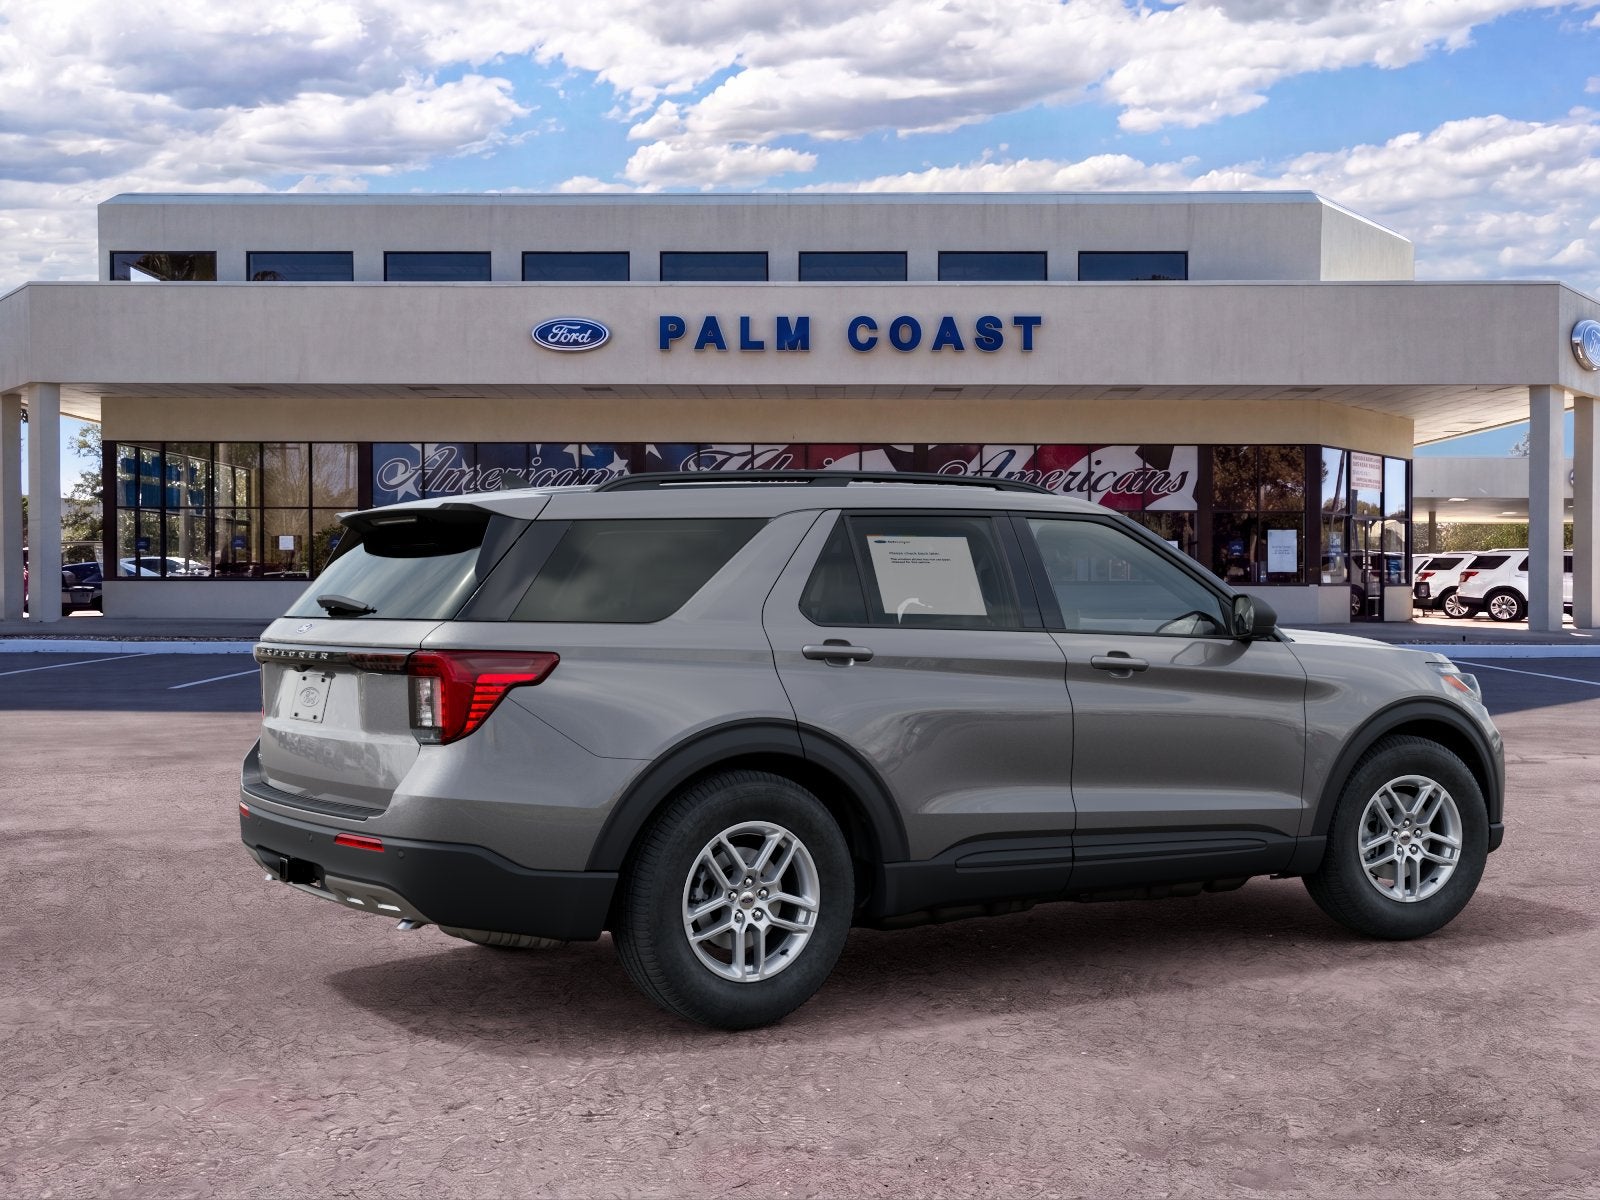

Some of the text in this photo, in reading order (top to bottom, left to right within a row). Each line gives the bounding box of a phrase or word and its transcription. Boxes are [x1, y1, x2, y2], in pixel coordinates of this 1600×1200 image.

[547, 324, 592, 343] Ford
[658, 315, 1043, 353] PALM COAST
